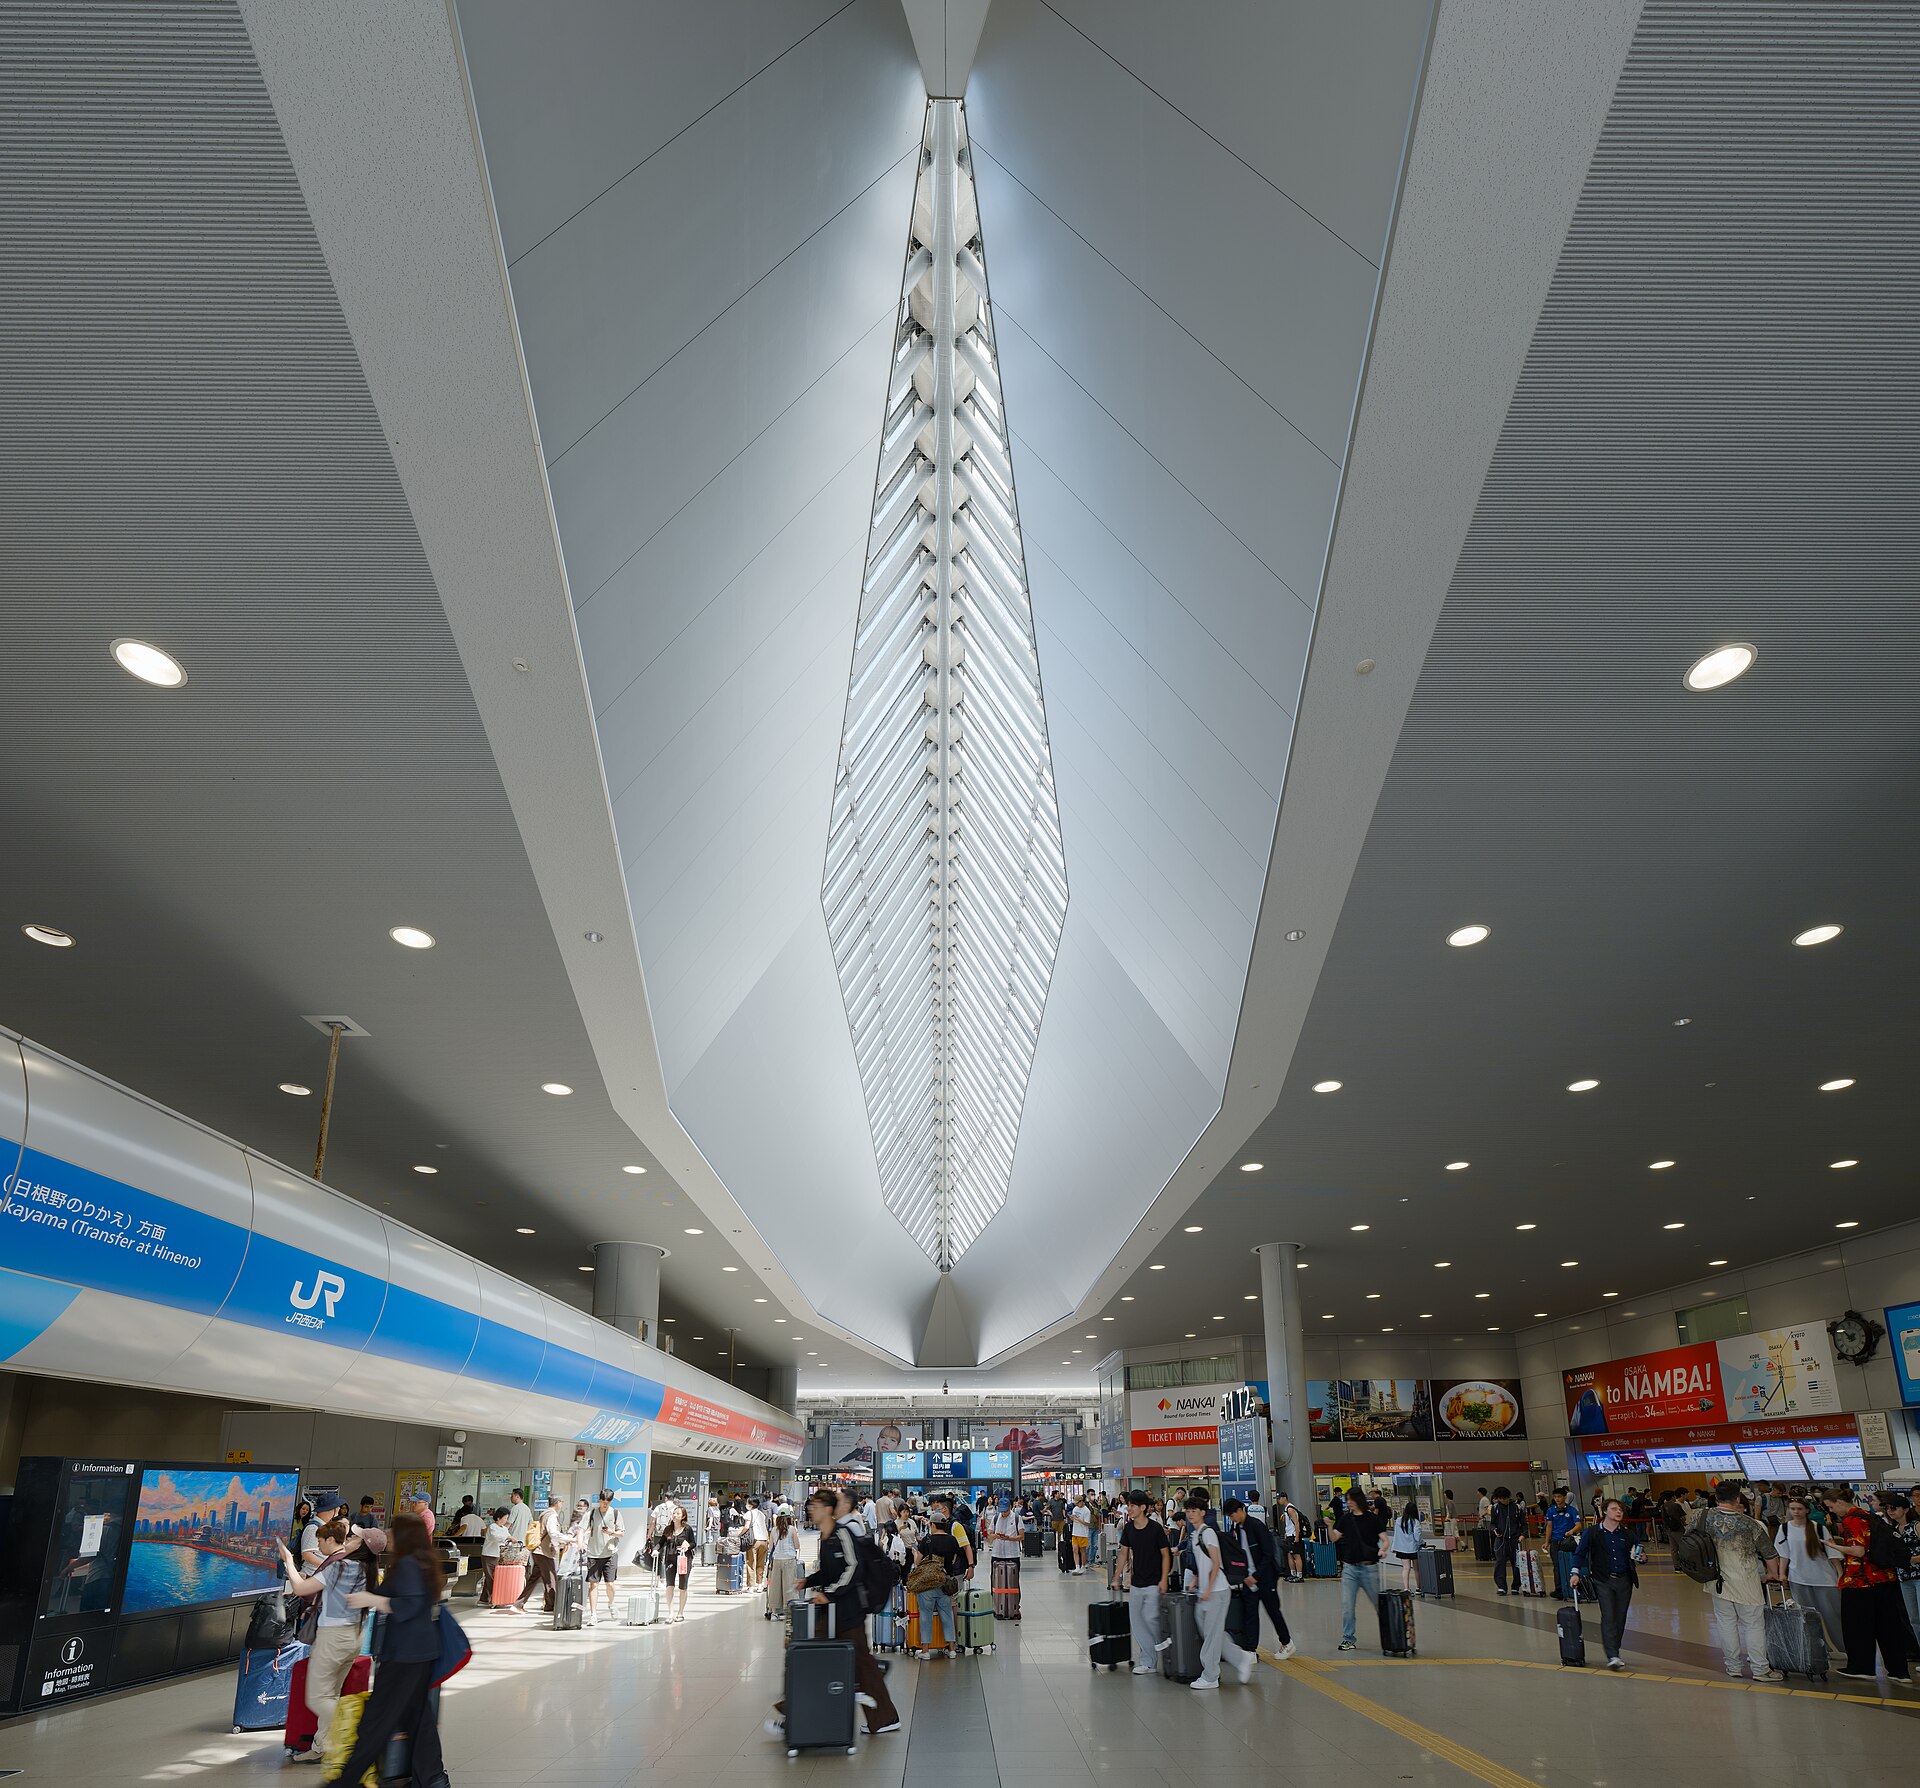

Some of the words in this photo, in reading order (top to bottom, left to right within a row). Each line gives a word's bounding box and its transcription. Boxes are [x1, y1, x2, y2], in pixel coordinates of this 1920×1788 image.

[0, 1197, 68, 1230] kayama
[71, 1218, 135, 1251] (Transfer
[136, 1240, 152, 1255] at
[152, 1244, 201, 1270] Hineno)
[290, 1270, 345, 1317] JR
[1624, 1364, 1647, 1376] OSAKA
[1574, 1371, 1595, 1383] NANKAI
[1606, 1384, 1621, 1404] to
[1624, 1363, 1711, 1402] NAMBA!
[1176, 1396, 1216, 1410] NANKAI
[1222, 1391, 1234, 1420] T1
[1236, 1386, 1250, 1418] T2
[1458, 1430, 1504, 1438] WAKAYAMA
[1696, 1430, 1716, 1438] NANKAI
[1791, 1424, 1818, 1433] Tickets
[1147, 1432, 1173, 1442] TICKET
[1600, 1439, 1615, 1447] Ticket
[1615, 1438, 1629, 1446] Office
[905, 1437, 976, 1450] Terminal
[982, 1437, 989, 1450] 1
[81, 1463, 123, 1473] Information
[620, 1461, 637, 1480] A
[535, 1472, 551, 1481] JR
[674, 1484, 697, 1493] ATM
[44, 1663, 94, 1680] Information
